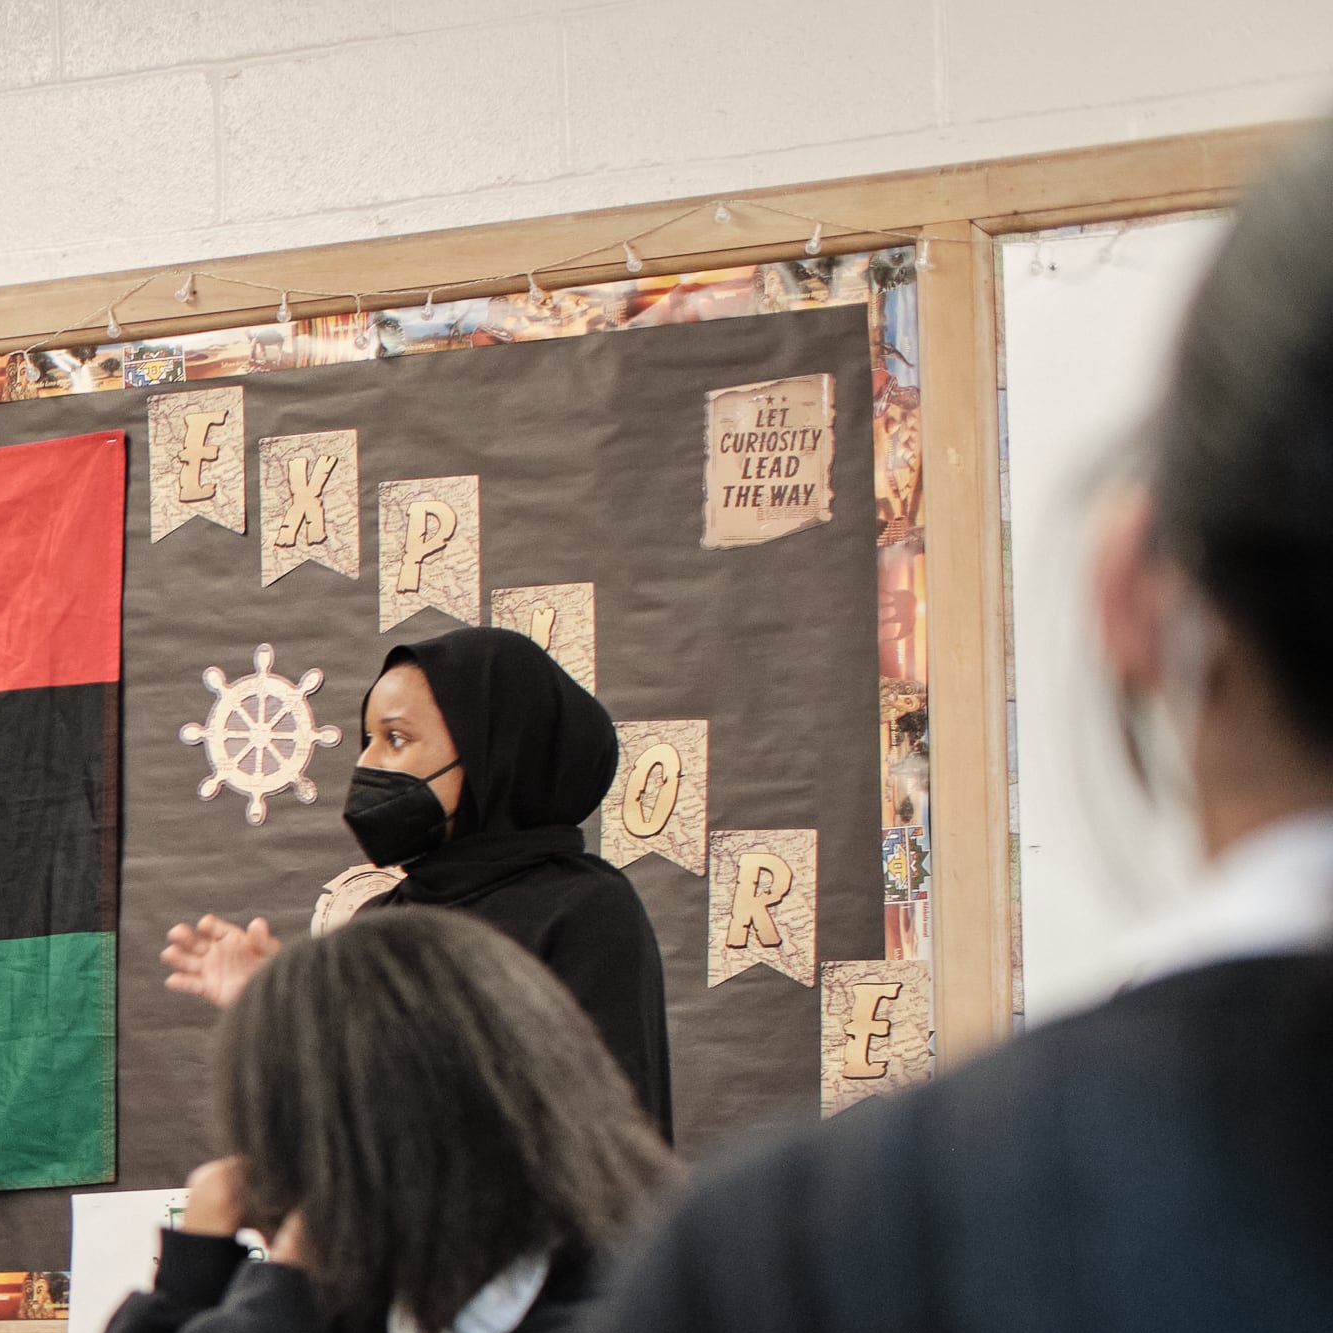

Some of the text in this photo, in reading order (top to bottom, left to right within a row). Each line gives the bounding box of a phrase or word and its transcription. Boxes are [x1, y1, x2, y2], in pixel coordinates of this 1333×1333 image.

[755, 408, 789, 428] LET
[720, 429, 822, 454] CURIOSITY
[741, 456, 800, 479] LEAD
[723, 483, 815, 508] THE WAY
